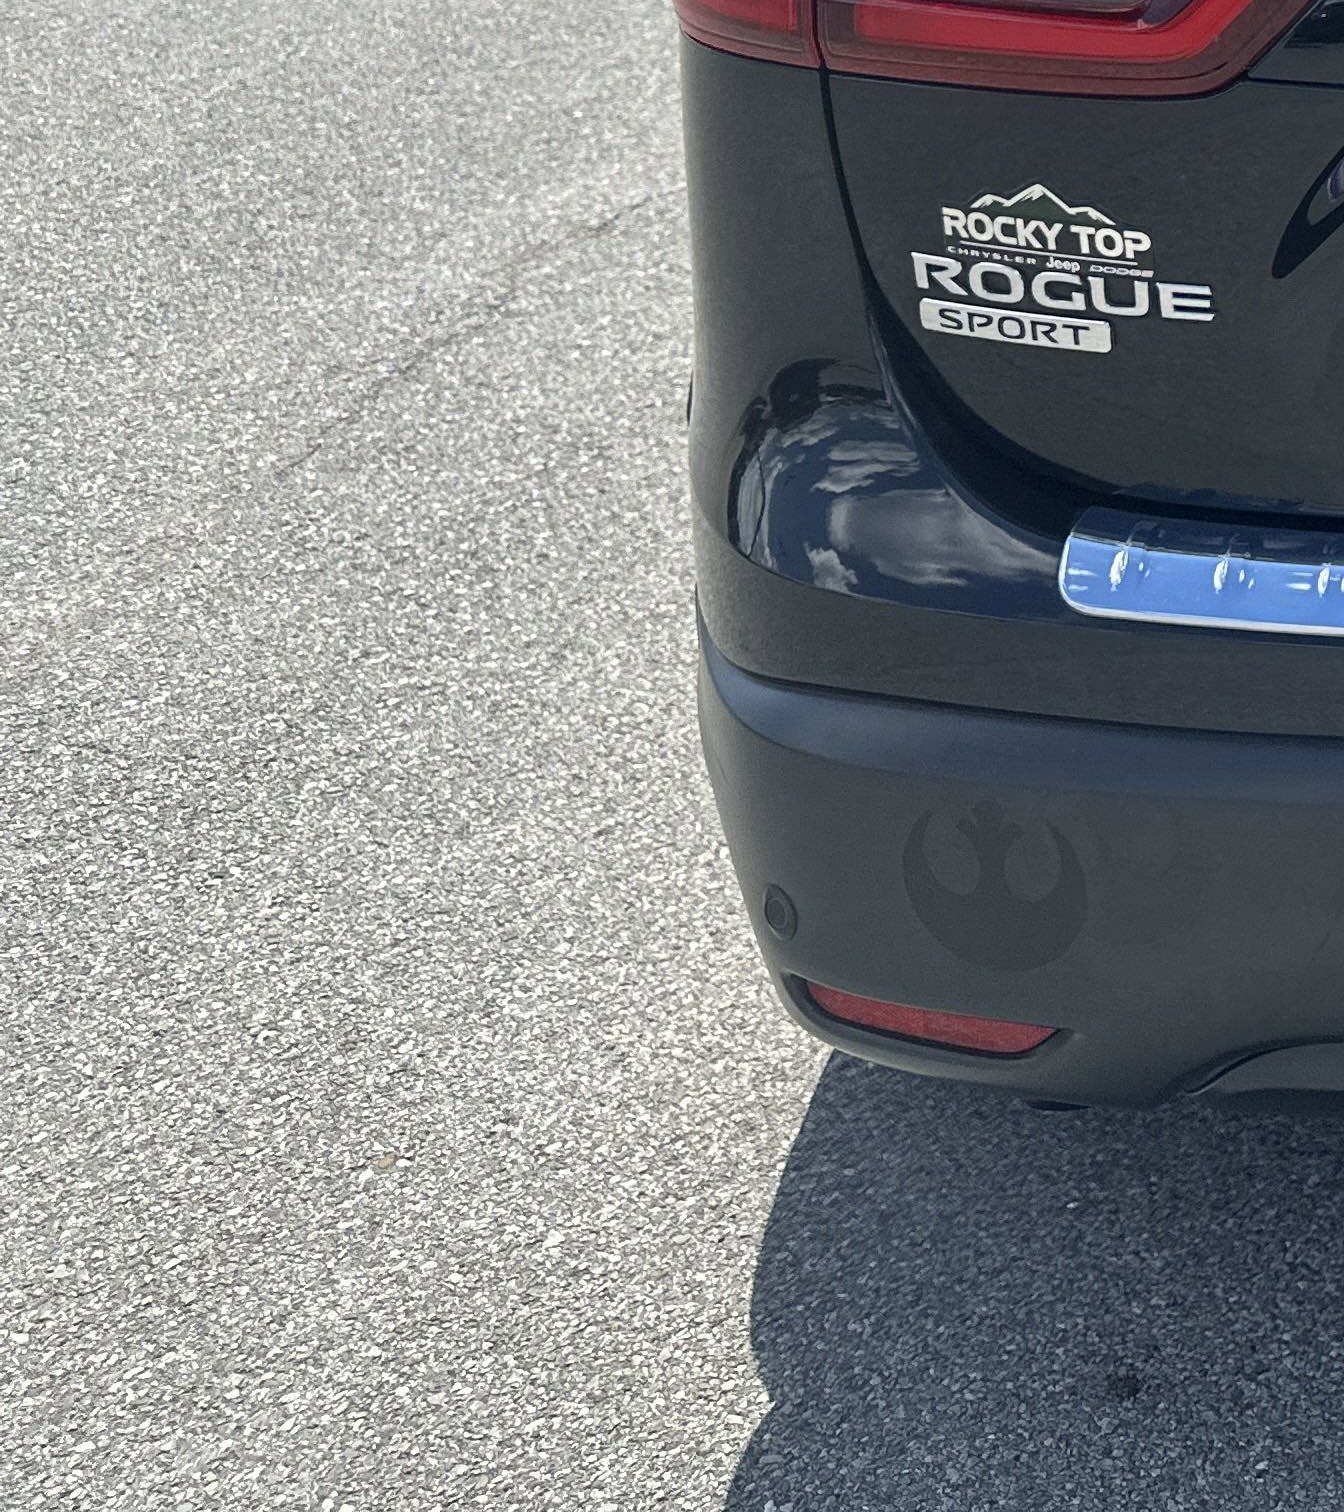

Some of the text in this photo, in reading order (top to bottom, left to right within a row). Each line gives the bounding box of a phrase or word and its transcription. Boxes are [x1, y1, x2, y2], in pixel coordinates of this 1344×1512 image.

[942, 207, 1152, 259] ROCKY TOP
[947, 245, 1154, 278] CHRYSLER Jeep DODGE
[911, 252, 1215, 321] ROGUE
[938, 308, 1090, 345] SPORT
